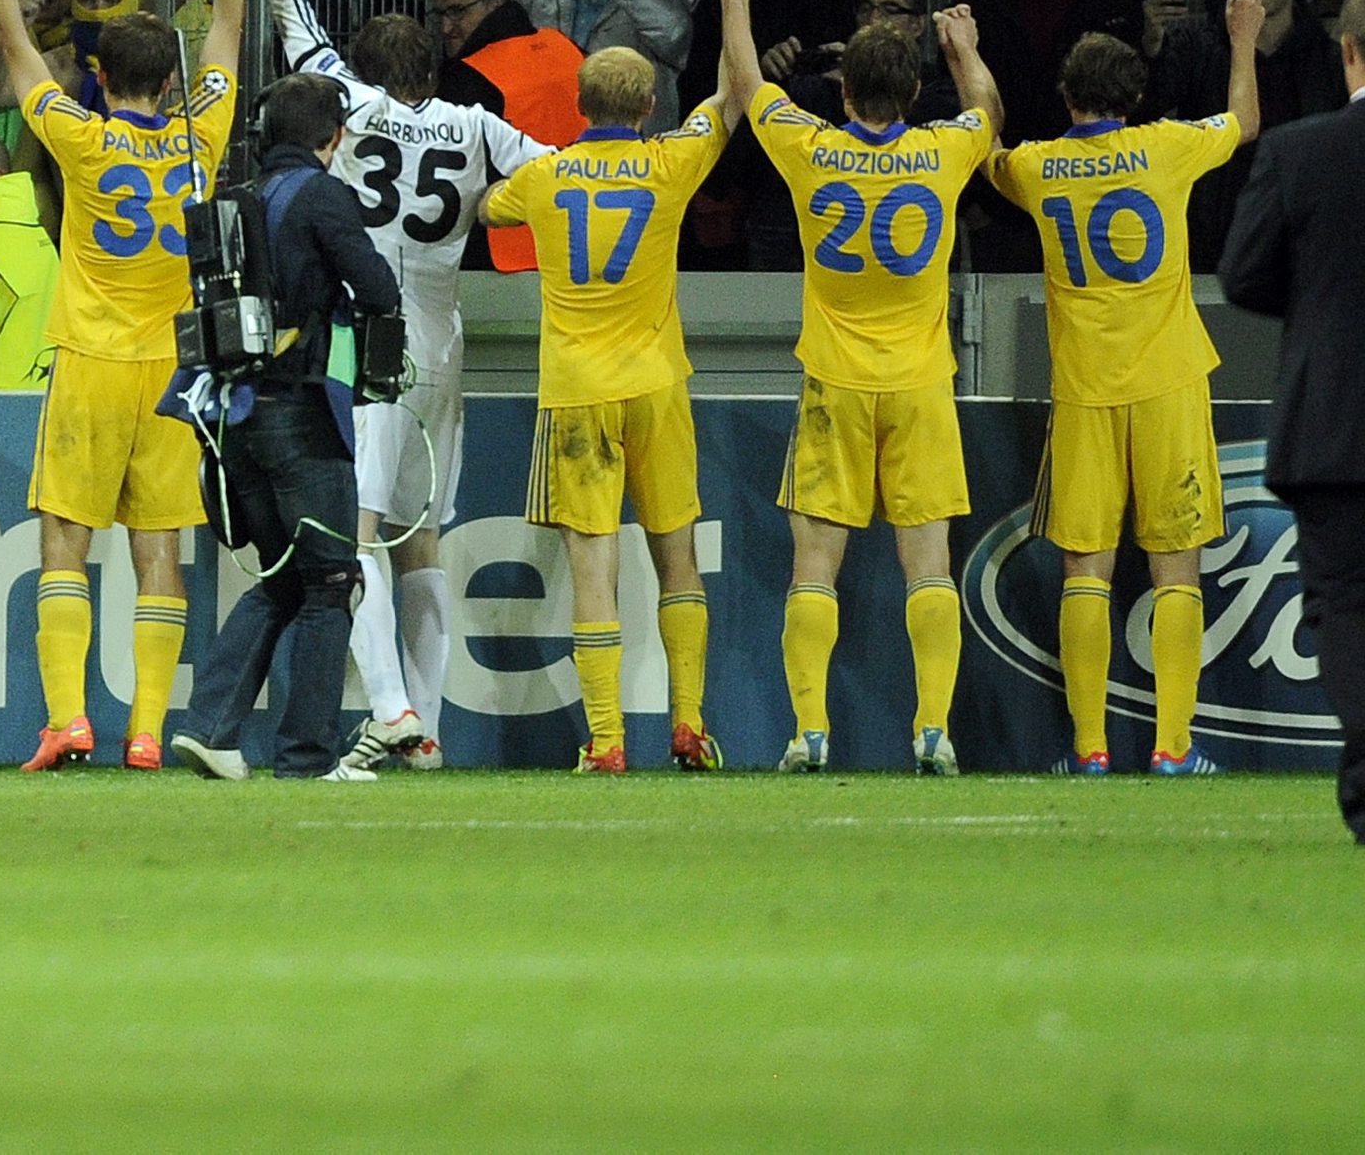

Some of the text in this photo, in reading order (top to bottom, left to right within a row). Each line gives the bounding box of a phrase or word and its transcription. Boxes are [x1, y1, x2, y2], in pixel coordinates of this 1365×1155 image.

[353, 135, 468, 243] 35
[555, 157, 651, 180] PAULAU
[811, 146, 940, 175] RADZIONAU
[1041, 148, 1150, 181] BRESSAN
[92, 163, 207, 258] 33
[553, 187, 656, 285] 17
[808, 180, 944, 277] 20
[1040, 186, 1166, 288] 10
